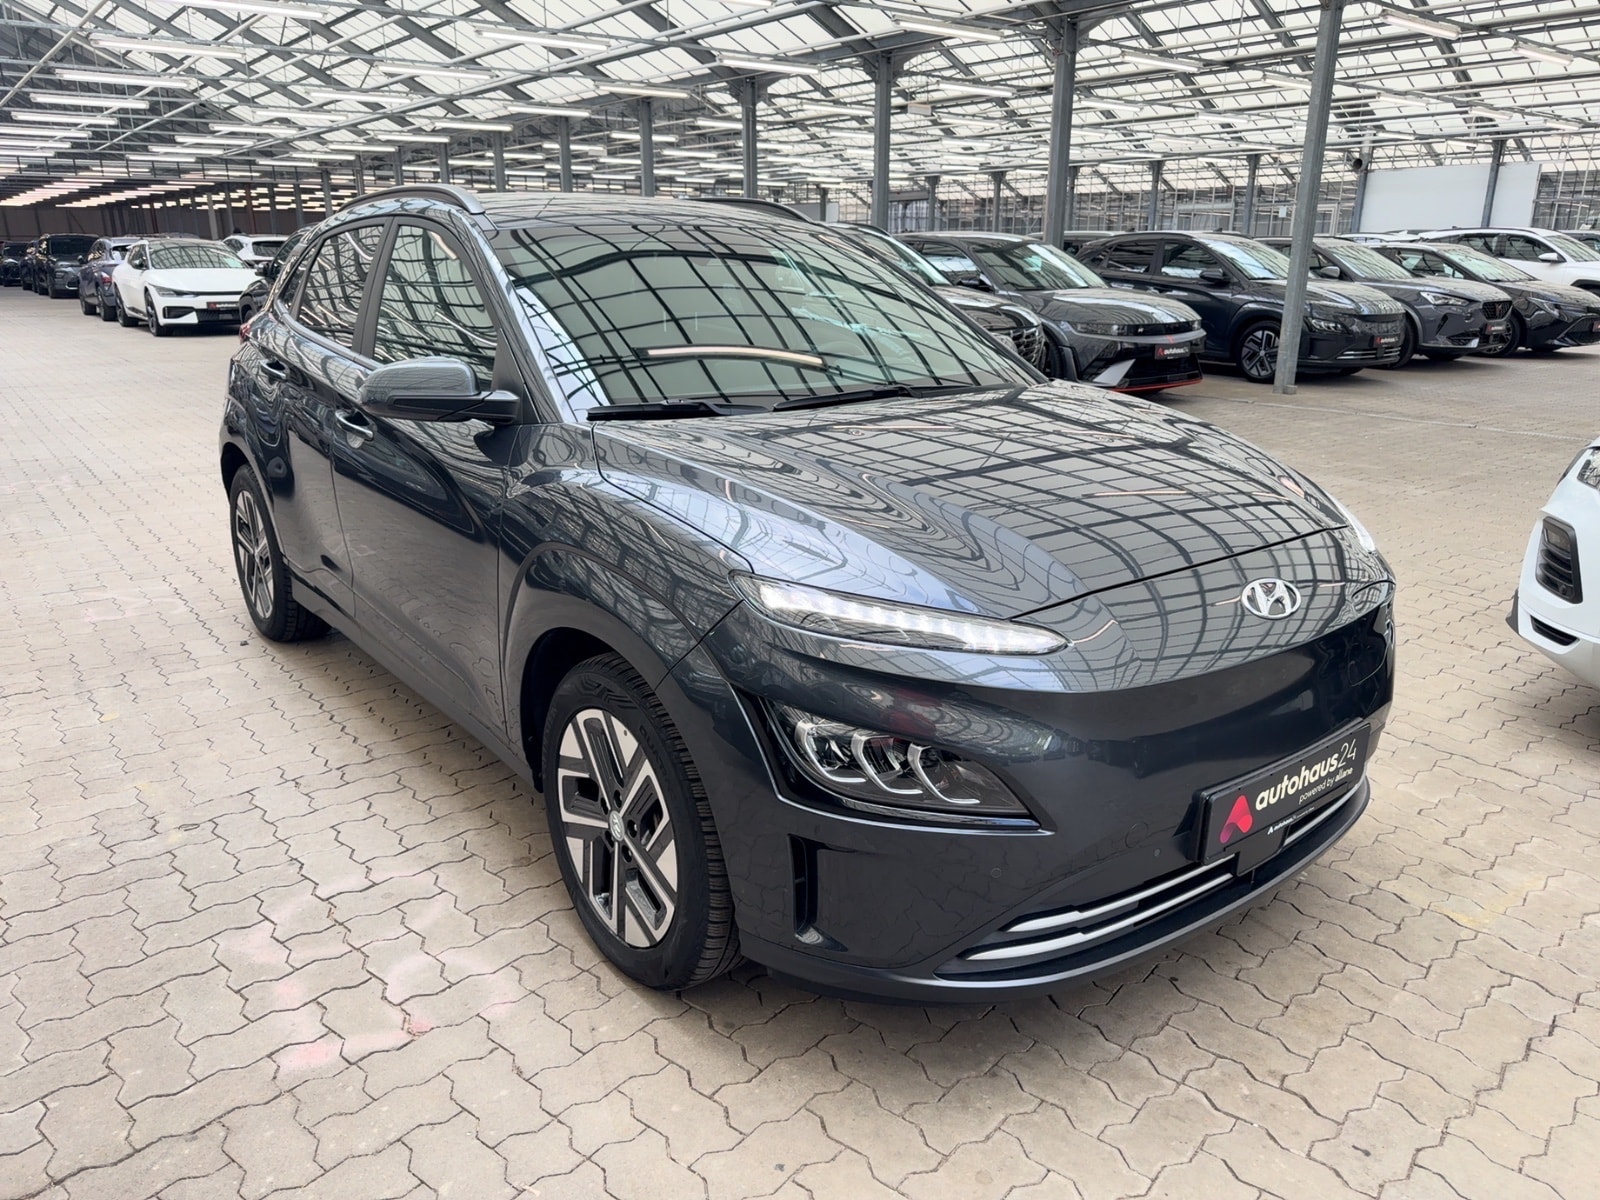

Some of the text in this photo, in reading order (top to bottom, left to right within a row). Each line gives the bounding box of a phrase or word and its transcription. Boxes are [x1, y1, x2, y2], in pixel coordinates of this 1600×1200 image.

[1255, 738, 1357, 811] autohaus24
[1298, 779, 1326, 805] powered
[1326, 777, 1335, 787] by
